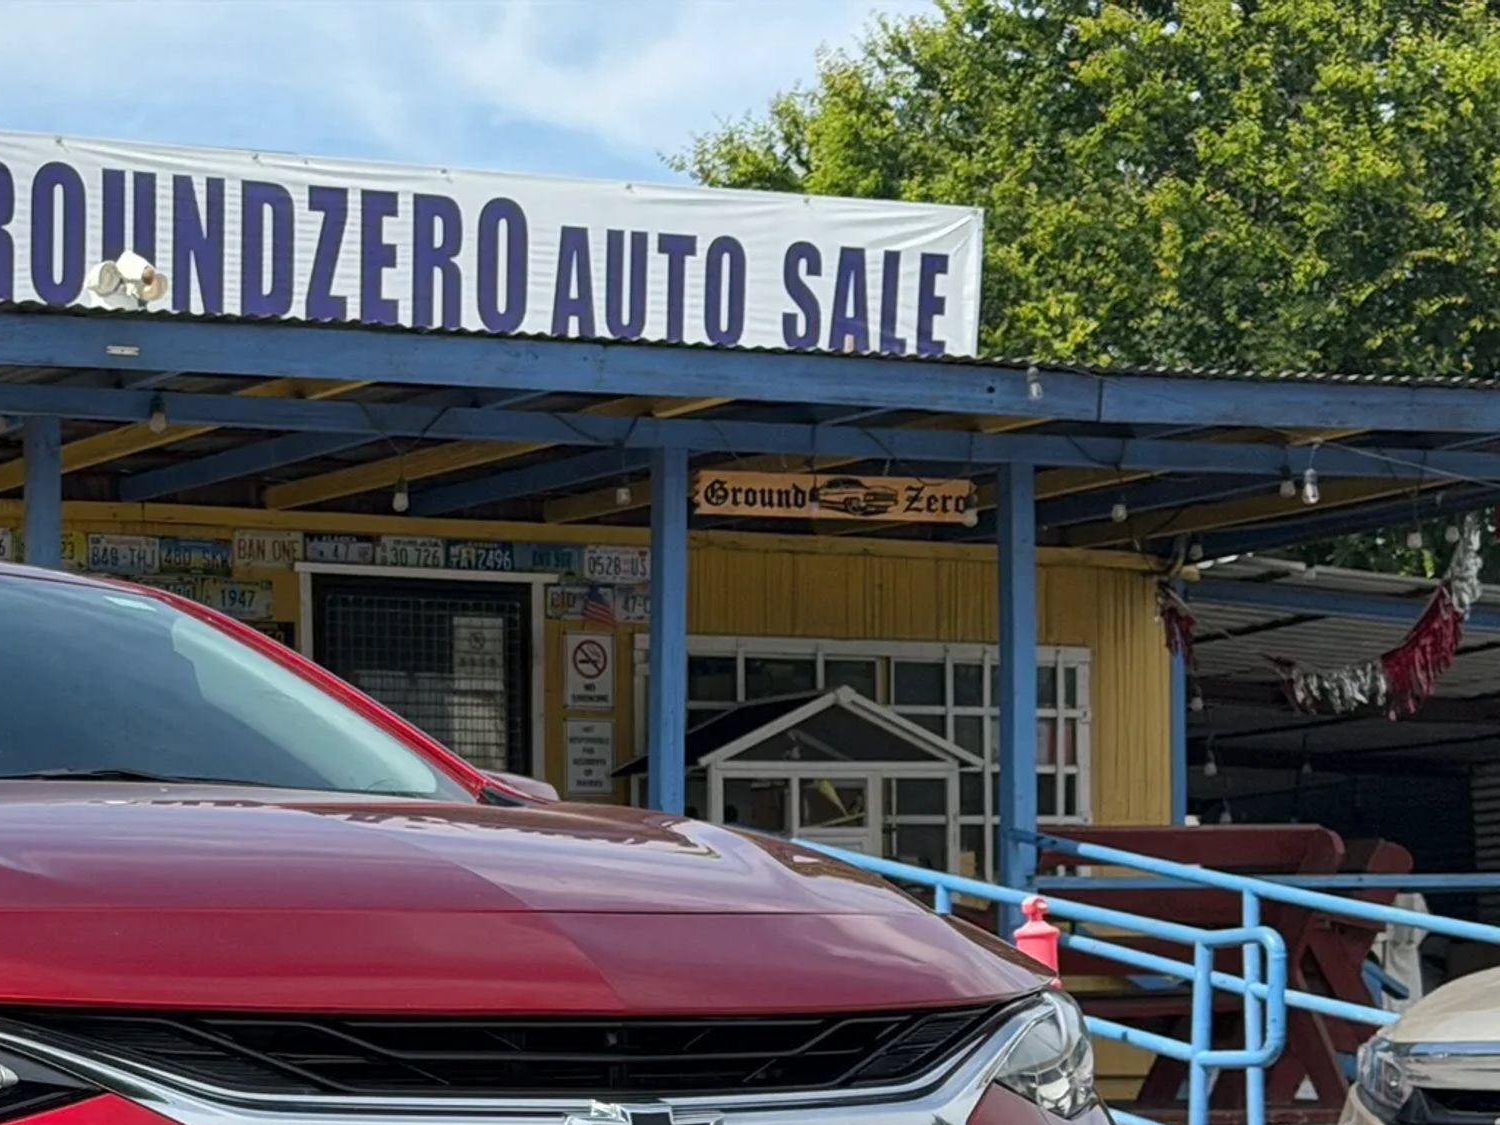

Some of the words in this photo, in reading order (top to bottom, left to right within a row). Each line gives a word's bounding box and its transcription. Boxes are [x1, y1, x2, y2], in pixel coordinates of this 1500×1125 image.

[551, 226, 746, 346] AUTO
[782, 241, 949, 354] SALE
[703, 479, 808, 510] Ground
[903, 485, 970, 514] Zero
[237, 539, 266, 559] BAN
[272, 541, 299, 561] ONE
[588, 556, 622, 576] 0528
[220, 588, 255, 608] 1947
